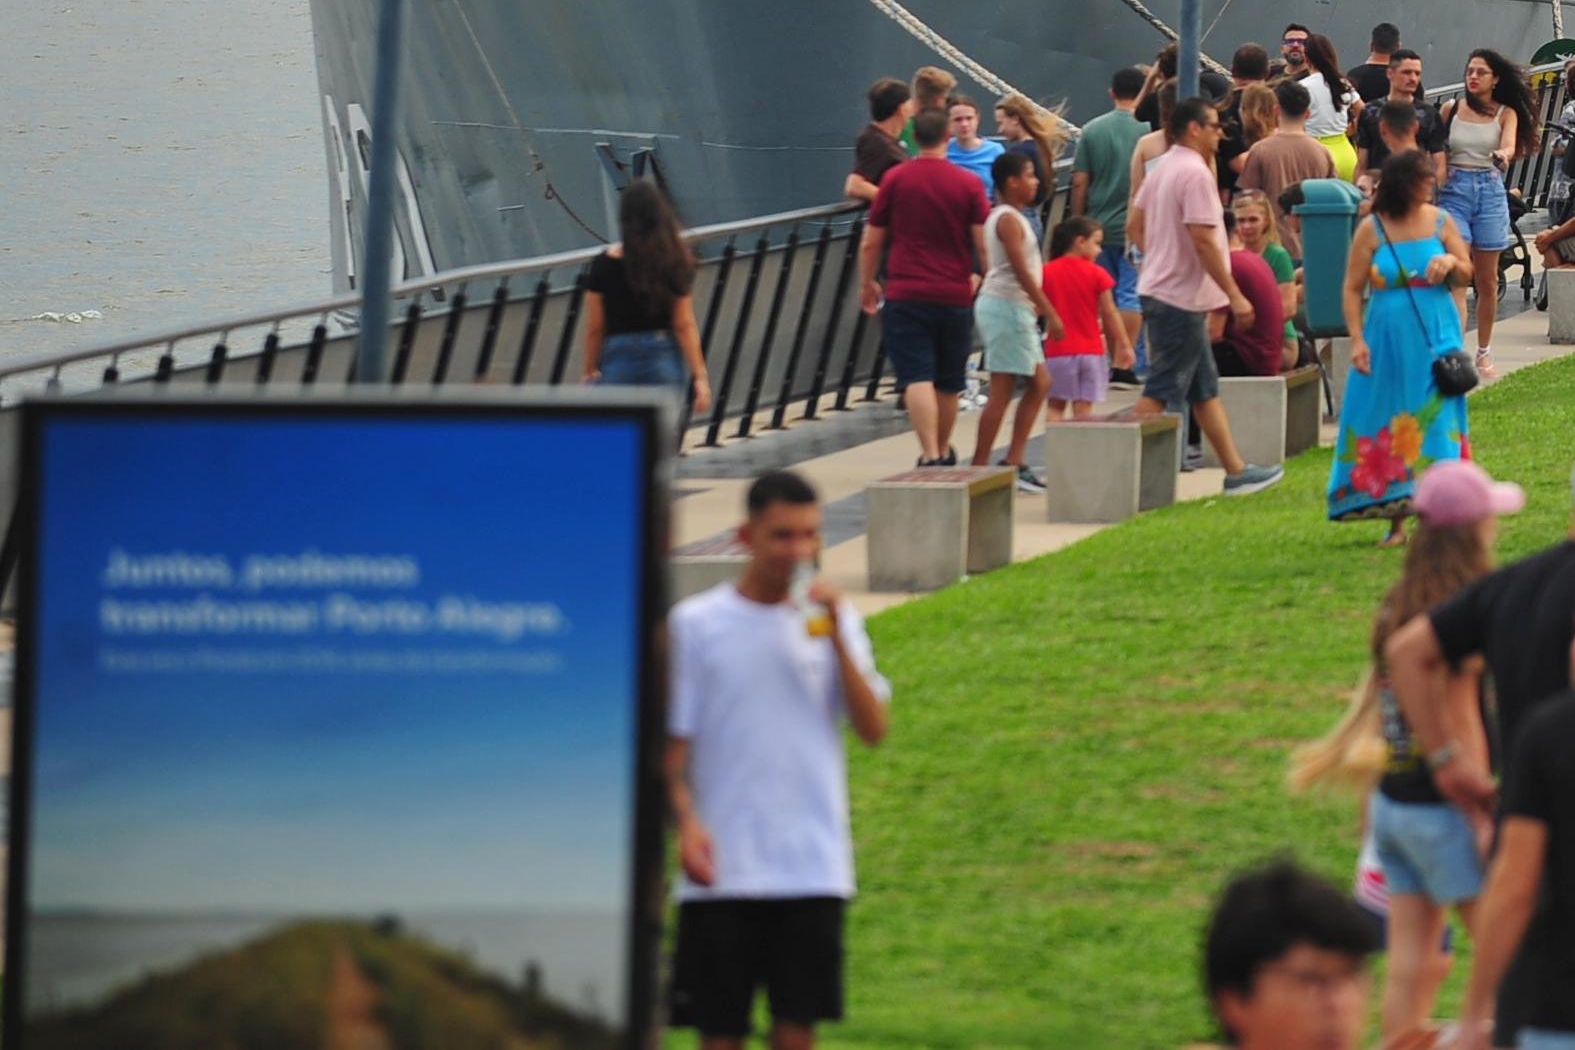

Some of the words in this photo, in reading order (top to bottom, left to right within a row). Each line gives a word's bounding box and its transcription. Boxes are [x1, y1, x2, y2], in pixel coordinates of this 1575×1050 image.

[243, 552, 417, 591] podemos
[102, 597, 321, 634] transformar
[329, 597, 430, 634] Porto
